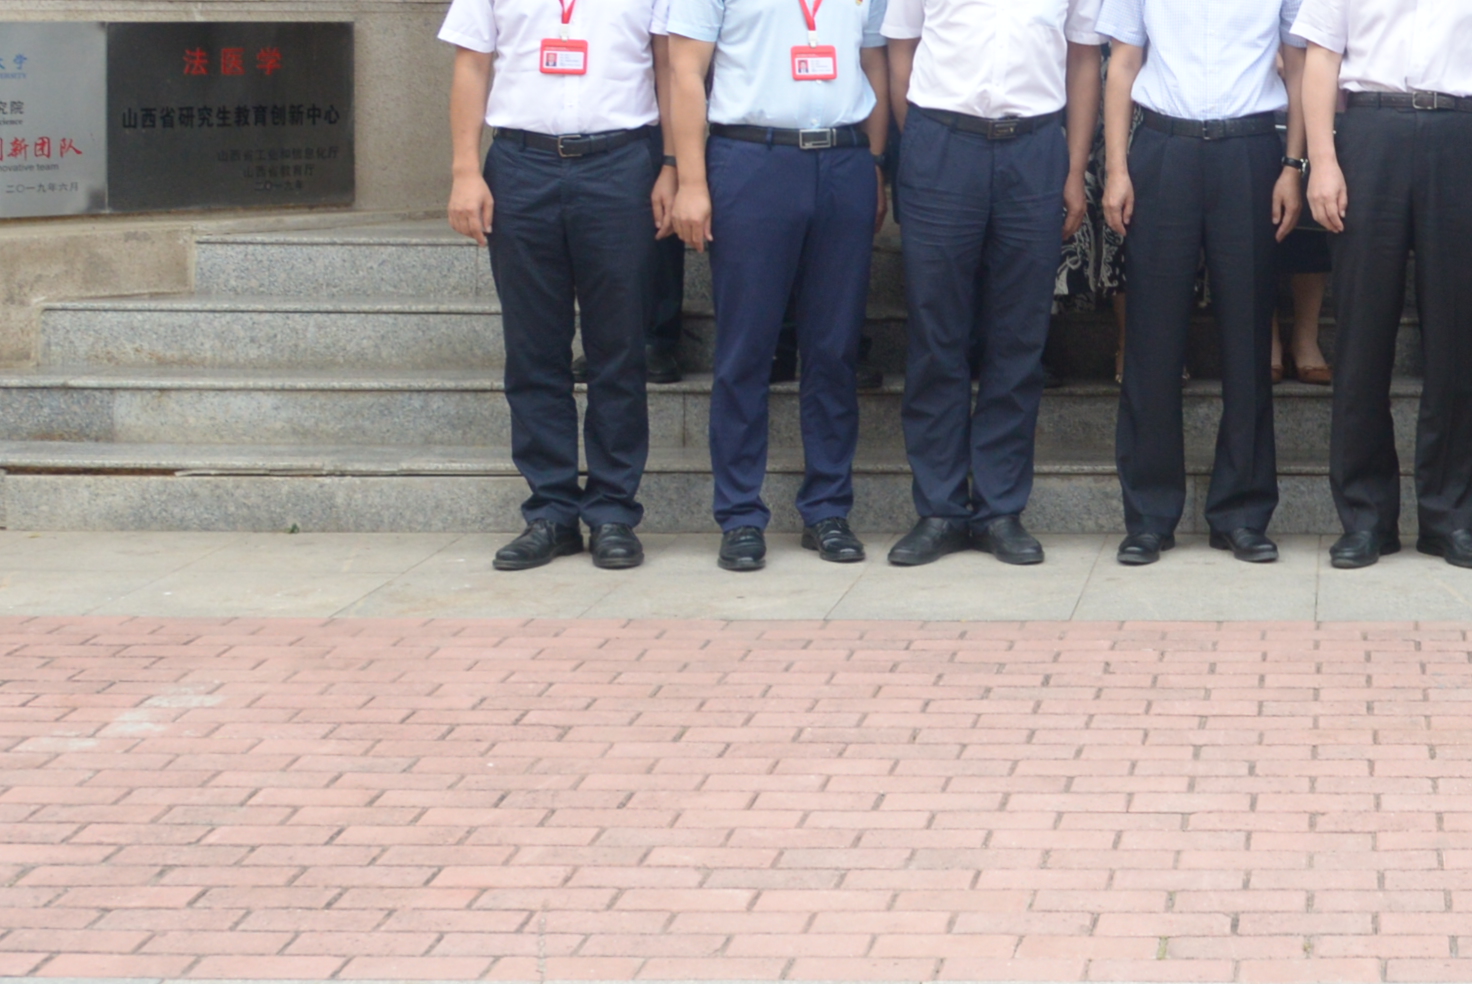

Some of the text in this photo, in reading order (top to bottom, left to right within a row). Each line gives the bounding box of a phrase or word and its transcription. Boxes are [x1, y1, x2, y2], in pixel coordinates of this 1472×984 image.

[183, 47, 283, 76] 法医学
[122, 103, 341, 130] 山西省研究生教育创新中心
[0, 136, 83, 161] 新团队
